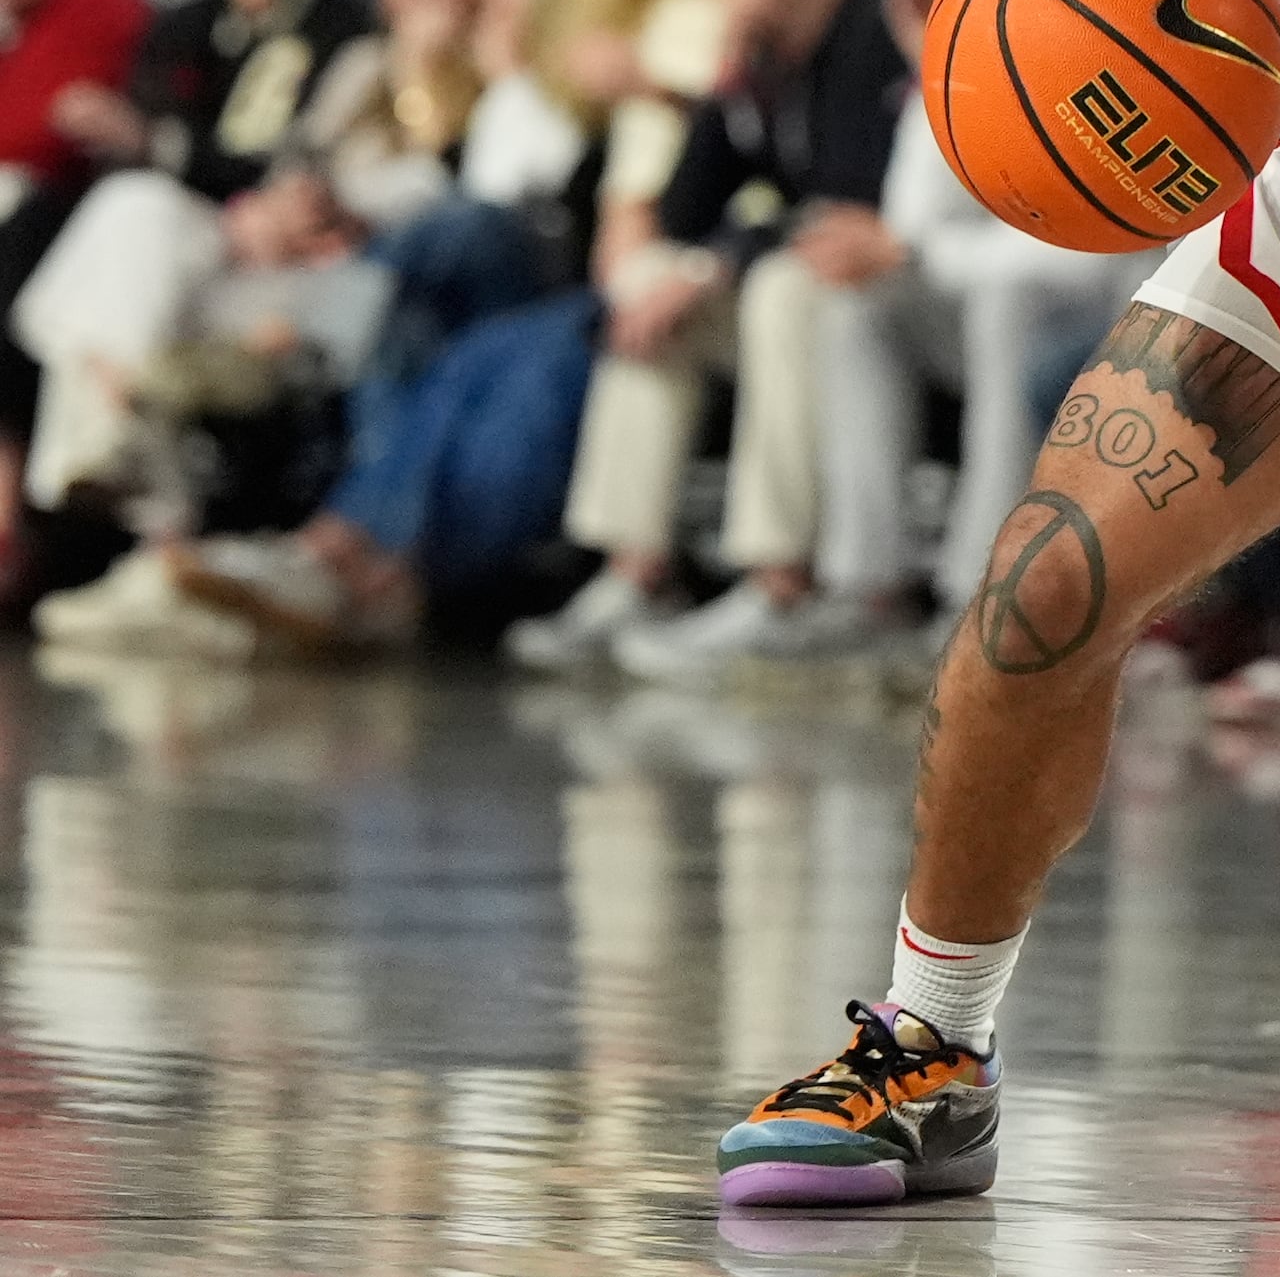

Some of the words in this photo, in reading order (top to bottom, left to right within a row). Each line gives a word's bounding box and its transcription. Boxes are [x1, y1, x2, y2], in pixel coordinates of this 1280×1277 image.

[1055, 102, 1179, 224] CHAMPIONSHIP
[1067, 68, 1222, 216] ELITE
[1047, 393, 1199, 511] 801
